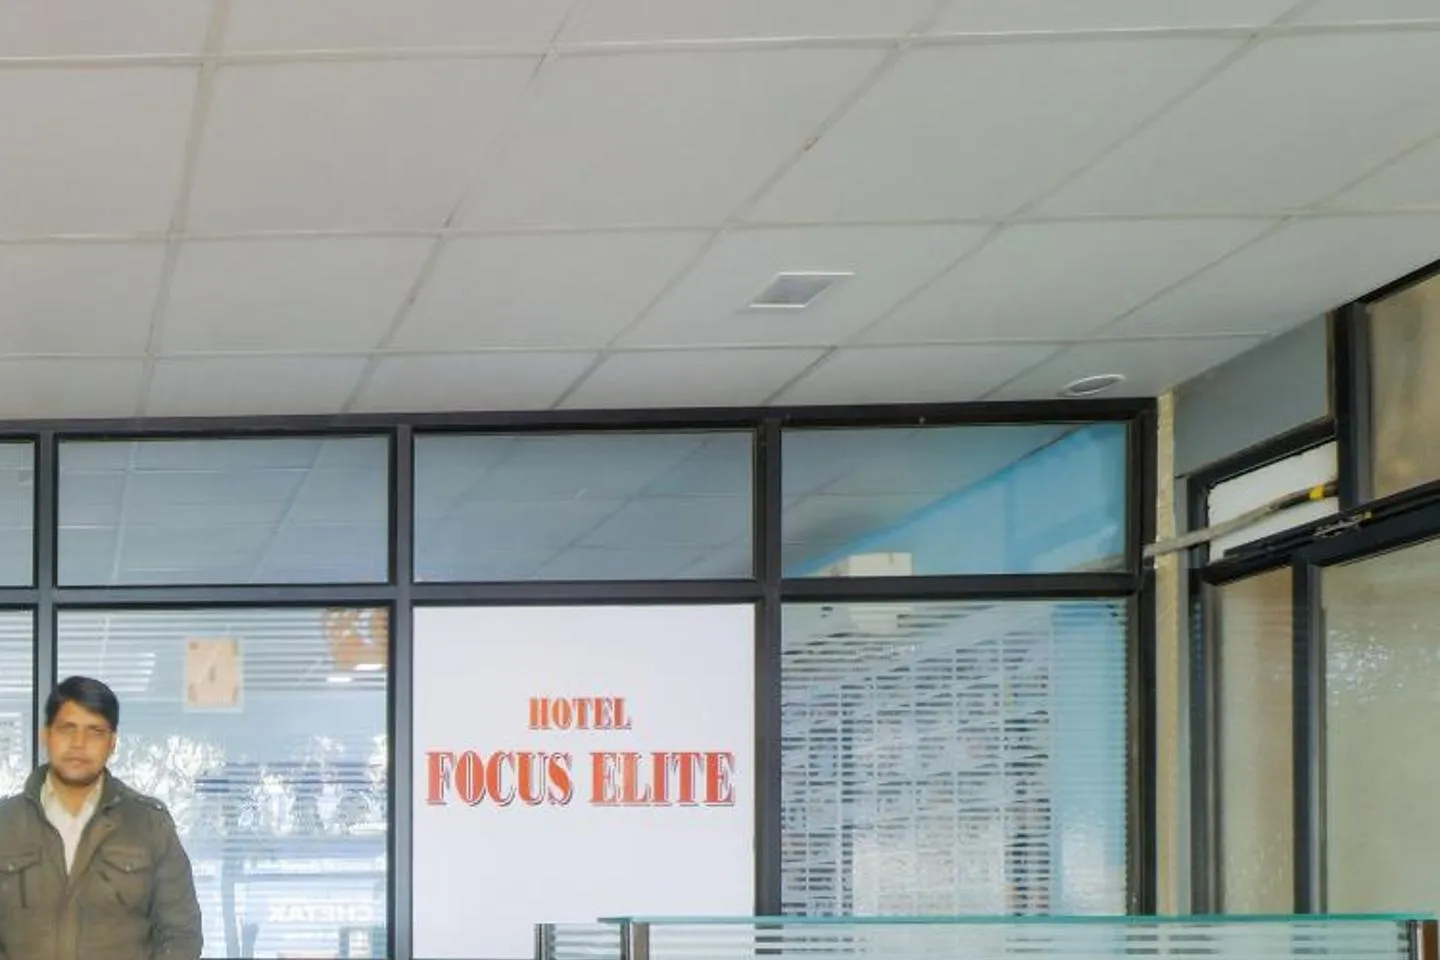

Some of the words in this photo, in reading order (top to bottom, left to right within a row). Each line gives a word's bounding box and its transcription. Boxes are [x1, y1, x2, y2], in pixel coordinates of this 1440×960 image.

[528, 697, 632, 731] HOTEL
[426, 751, 574, 808] FOCUS
[589, 751, 736, 808] ELITE
